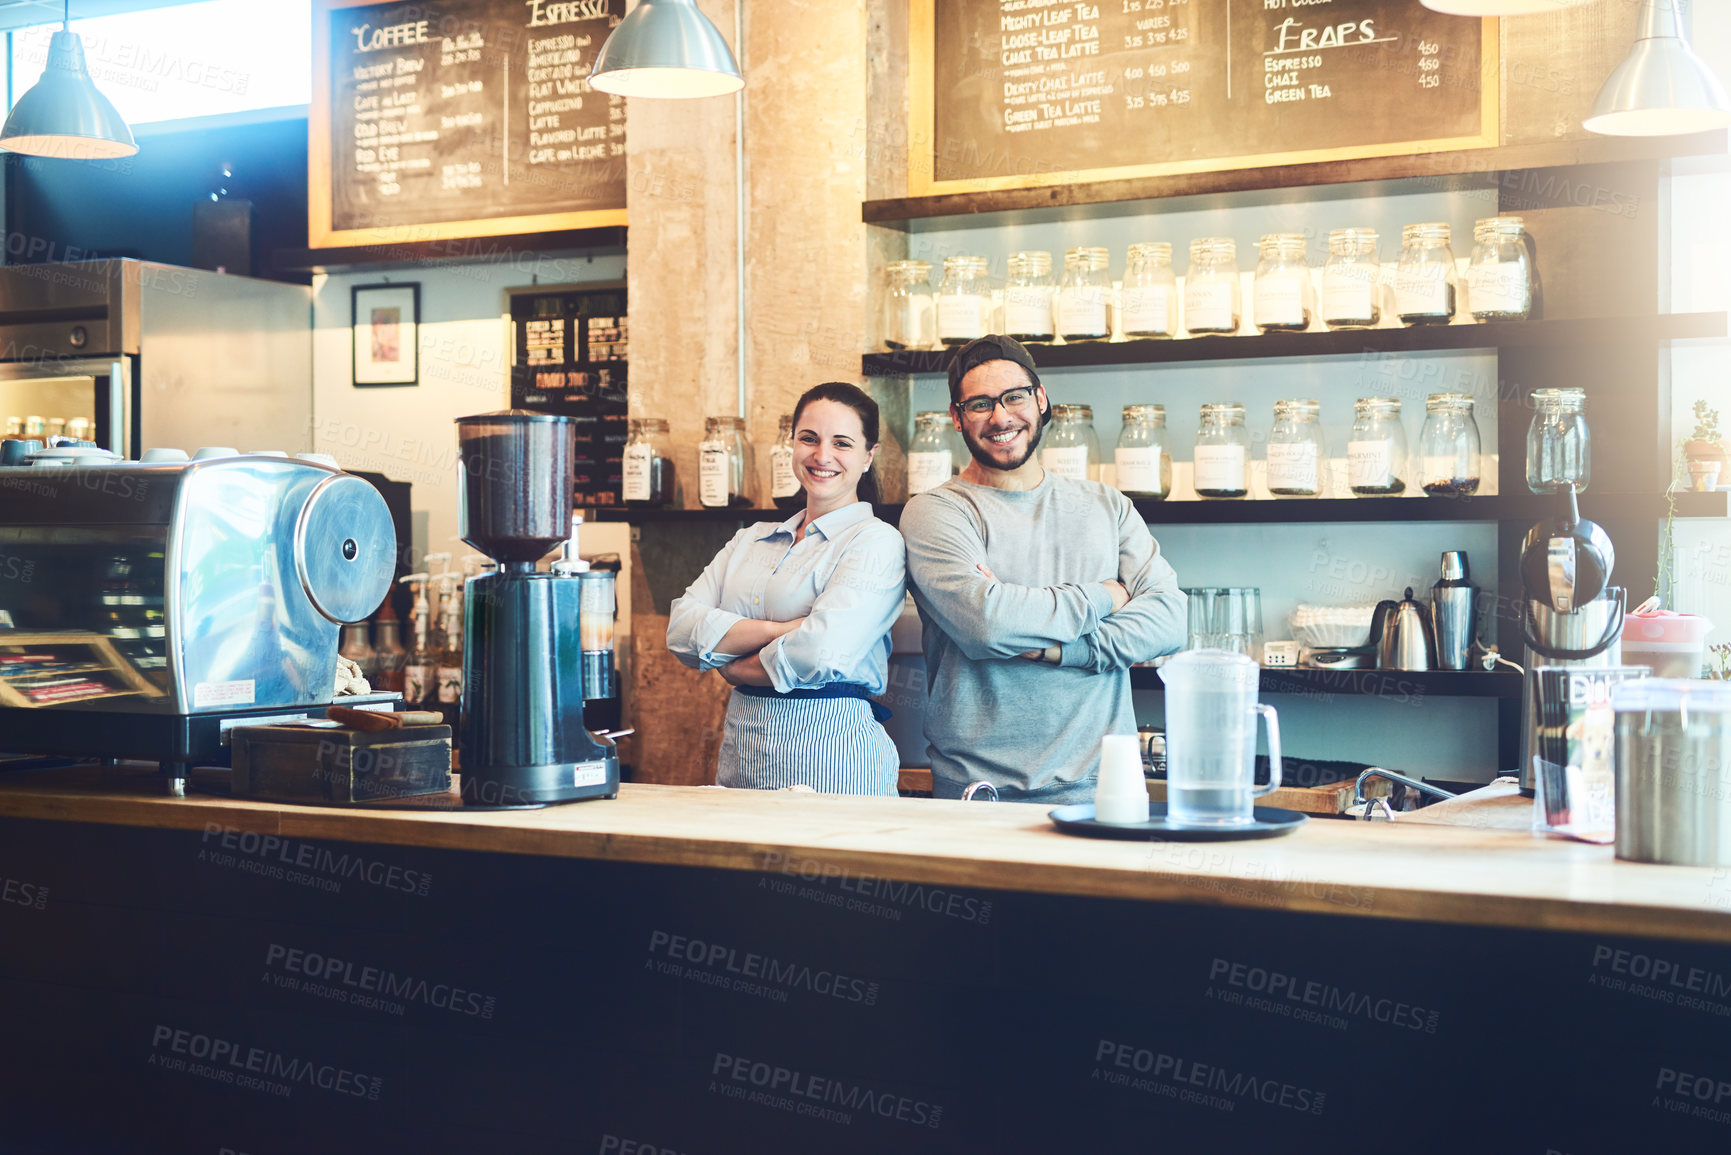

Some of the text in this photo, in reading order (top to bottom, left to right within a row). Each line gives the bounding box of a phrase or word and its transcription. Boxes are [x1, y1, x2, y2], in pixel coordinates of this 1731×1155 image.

[525, 0, 609, 27] ESPRESSO
[1001, 12, 1042, 31] MIGHTY
[1043, 9, 1072, 26] LEAF
[1074, 3, 1099, 21] TEA
[1136, 16, 1171, 31] VARIES
[354, 21, 429, 52] COFFEE
[1072, 24, 1099, 41] TEA
[1273, 17, 1376, 51] FRAPS
[1002, 41, 1100, 66] CHAI TEA LATTE
[1264, 55, 1323, 72] ESPRESSO
[1039, 77, 1068, 93] CHAI
[1071, 72, 1105, 88] LATTE
[1265, 72, 1299, 89] CHAI
[1265, 84, 1332, 104] GREEN TEA
[1004, 108, 1038, 125] GREEN
[1038, 103, 1063, 120] TEA
[1065, 100, 1102, 116] LATTE
